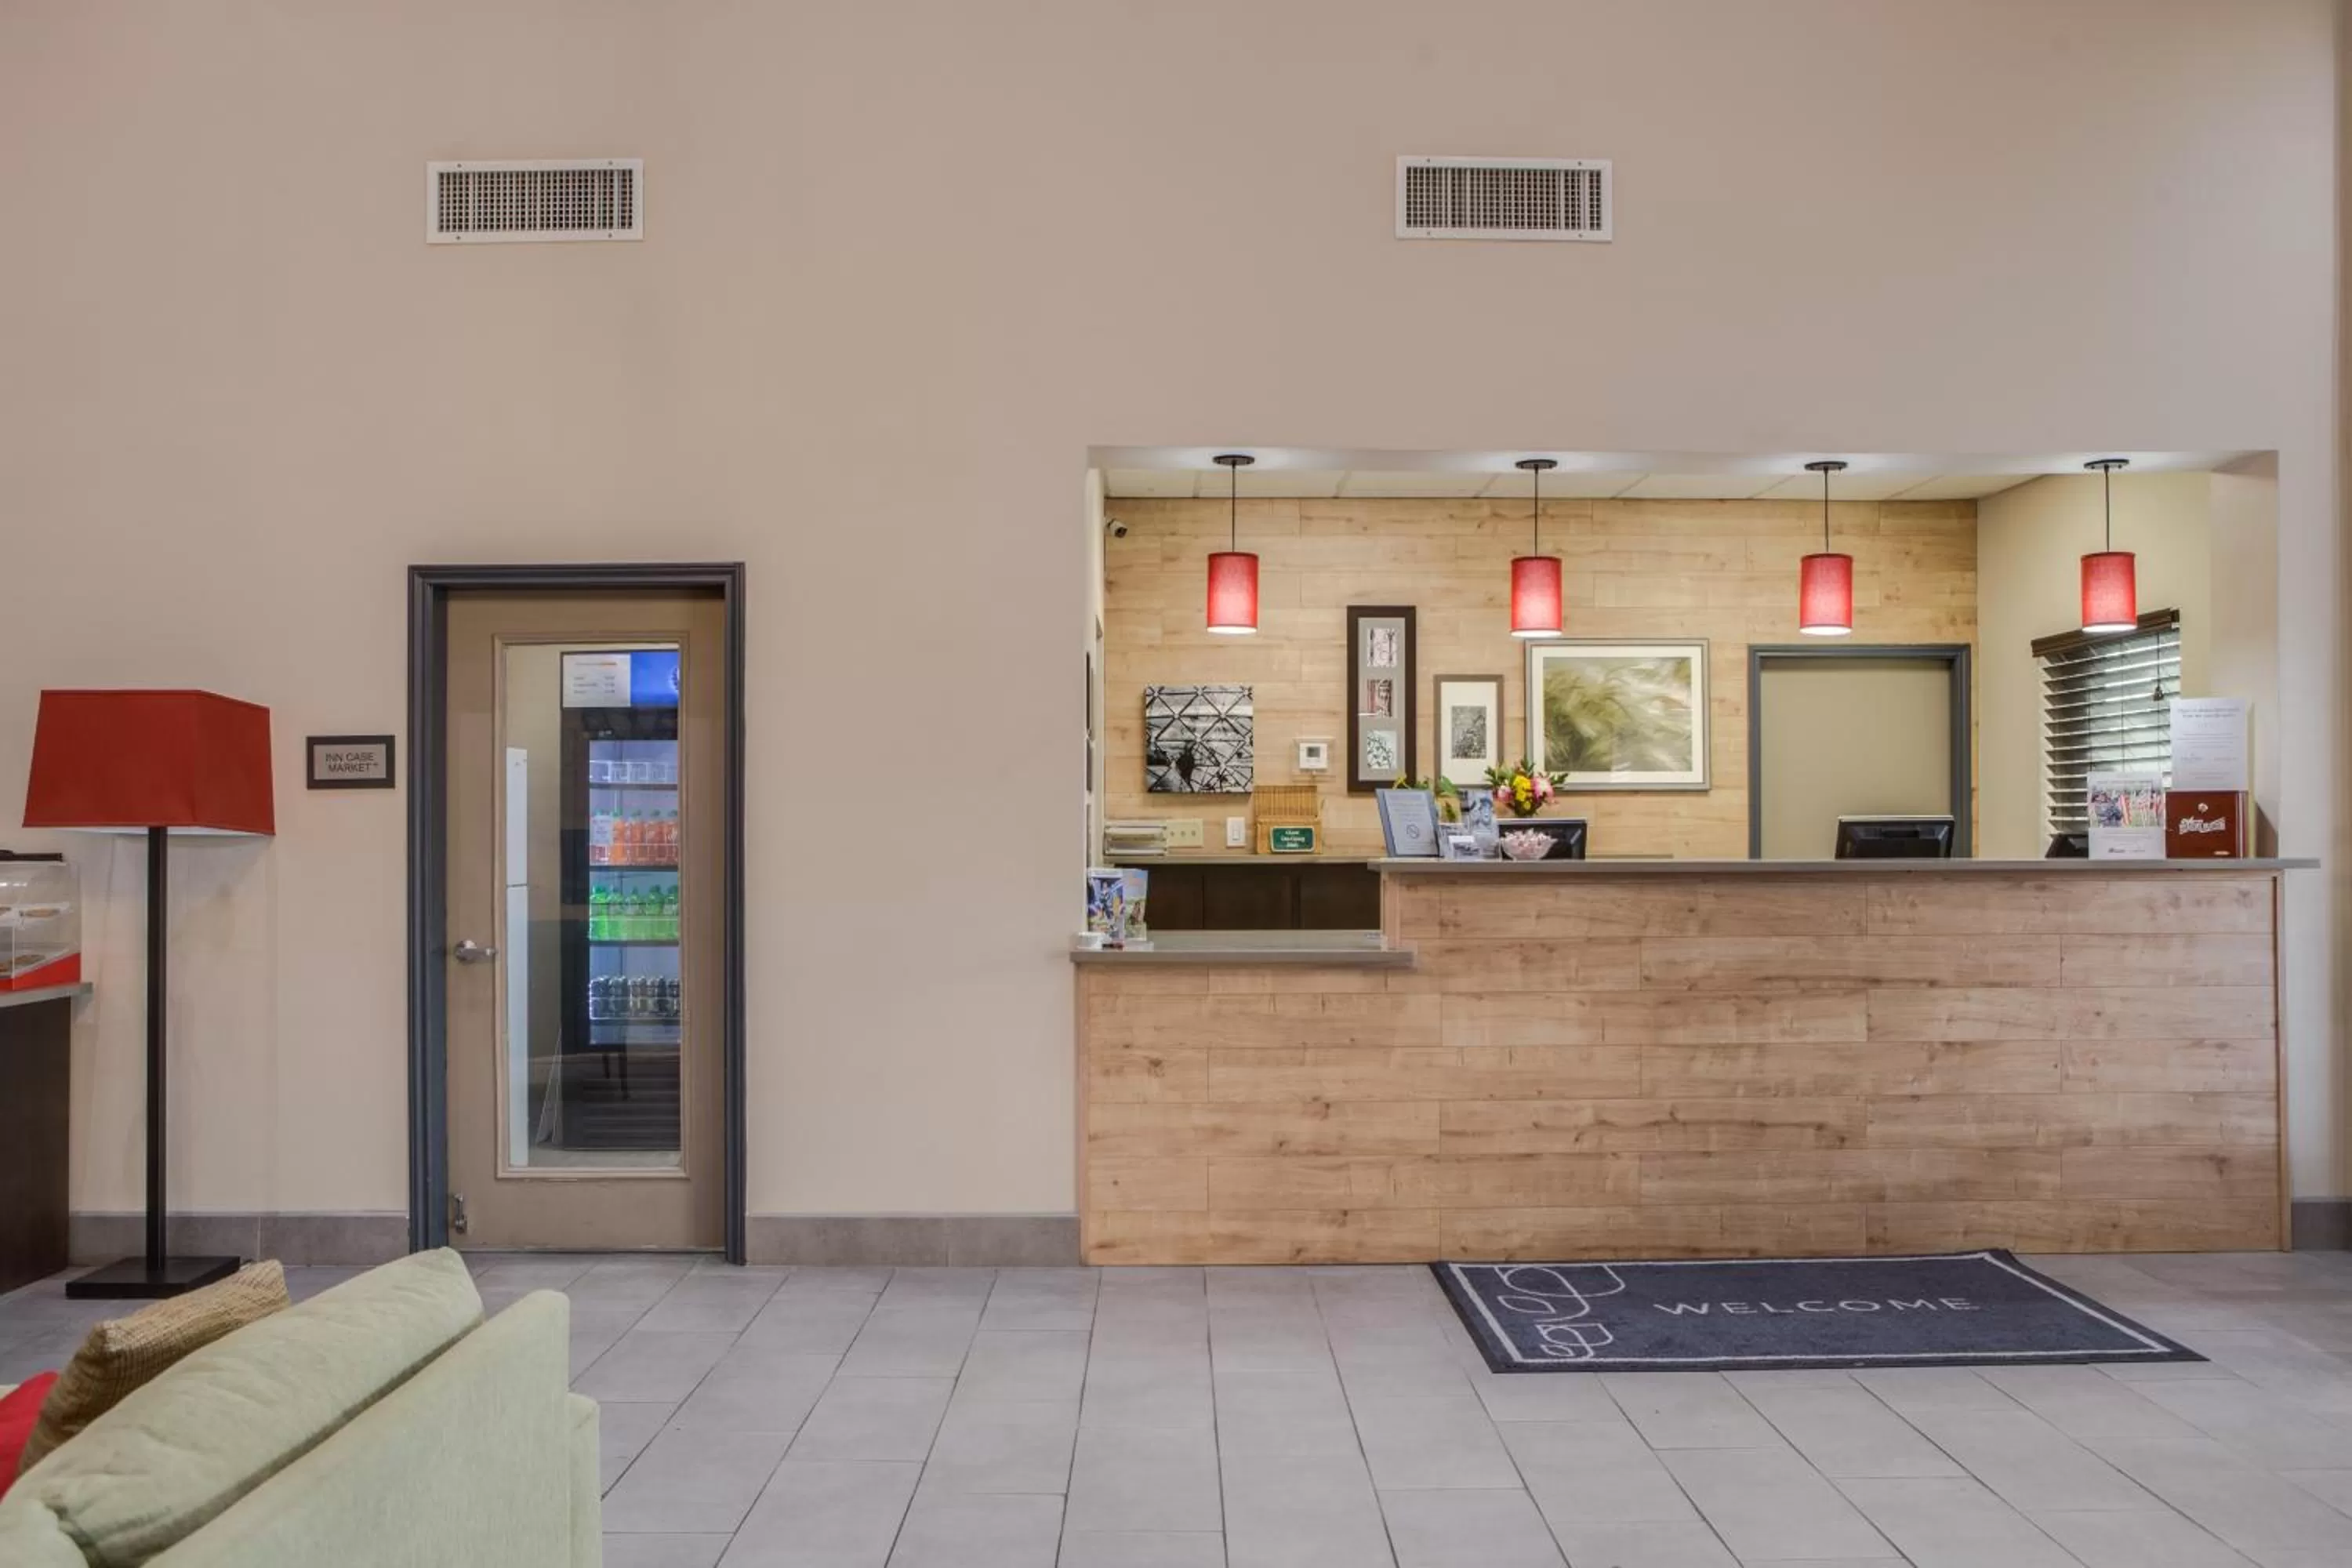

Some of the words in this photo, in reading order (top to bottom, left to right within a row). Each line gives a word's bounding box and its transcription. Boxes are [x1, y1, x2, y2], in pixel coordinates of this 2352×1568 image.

[325, 752, 343, 762] INN
[346, 752, 374, 762] CASE
[1653, 1298, 1980, 1316] WELCOME
